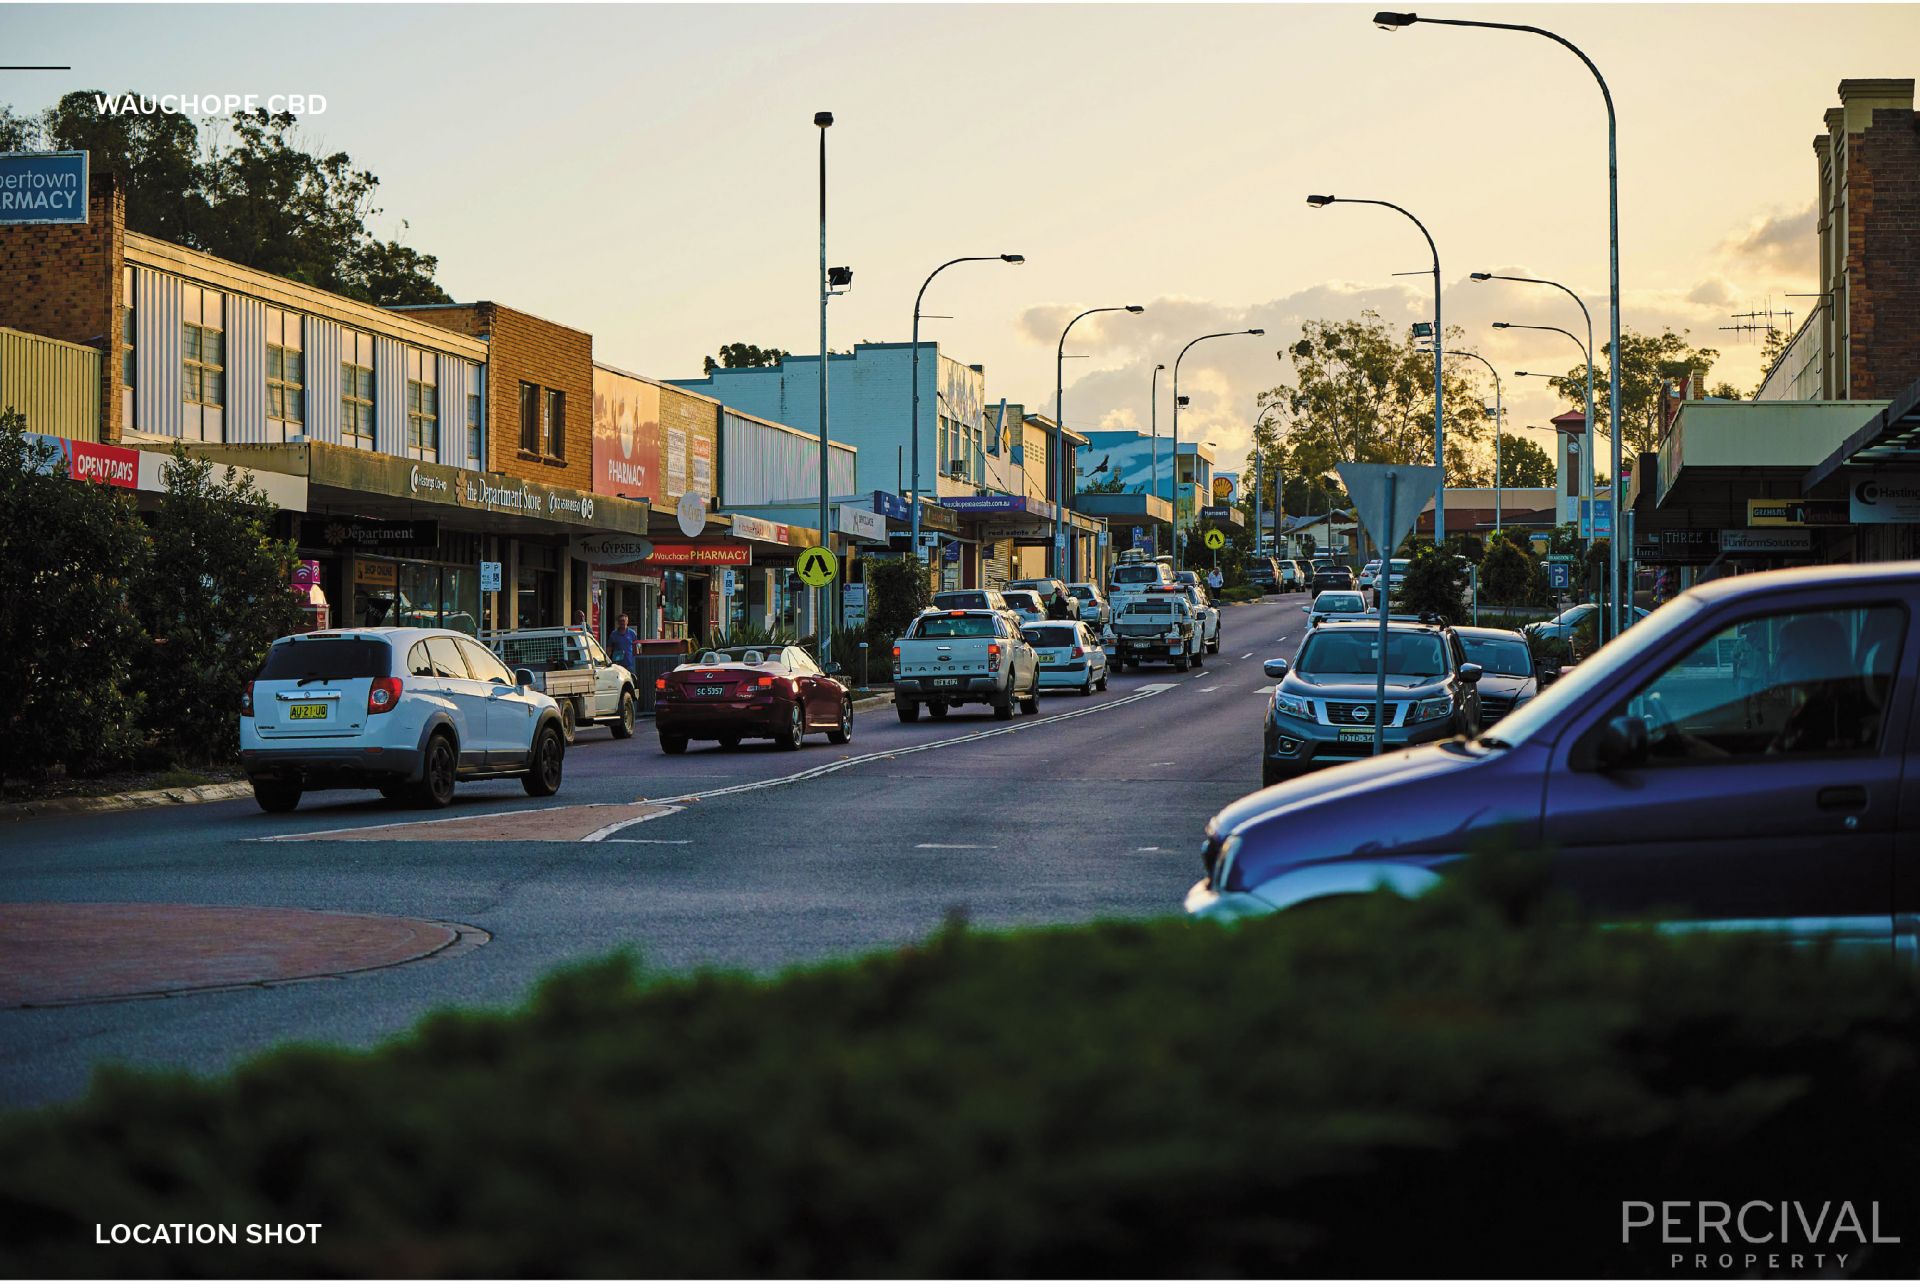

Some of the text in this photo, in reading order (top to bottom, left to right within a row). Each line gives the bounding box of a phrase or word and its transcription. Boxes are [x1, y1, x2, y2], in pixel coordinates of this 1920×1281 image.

[0, 190, 77, 209] RMACY
[77, 454, 133, 482] OPEN 7 DAYS
[608, 458, 646, 486] PHARMACY
[467, 481, 478, 501] the
[479, 479, 523, 511] Department
[523, 485, 542, 510] Store
[1664, 532, 1703, 543] THREE
[601, 541, 641, 554] GYPSIES
[654, 552, 689, 561] Wauchope
[690, 550, 748, 560] PHARMACY
[1555, 575, 1564, 586] P
[904, 664, 985, 673] RANGER
